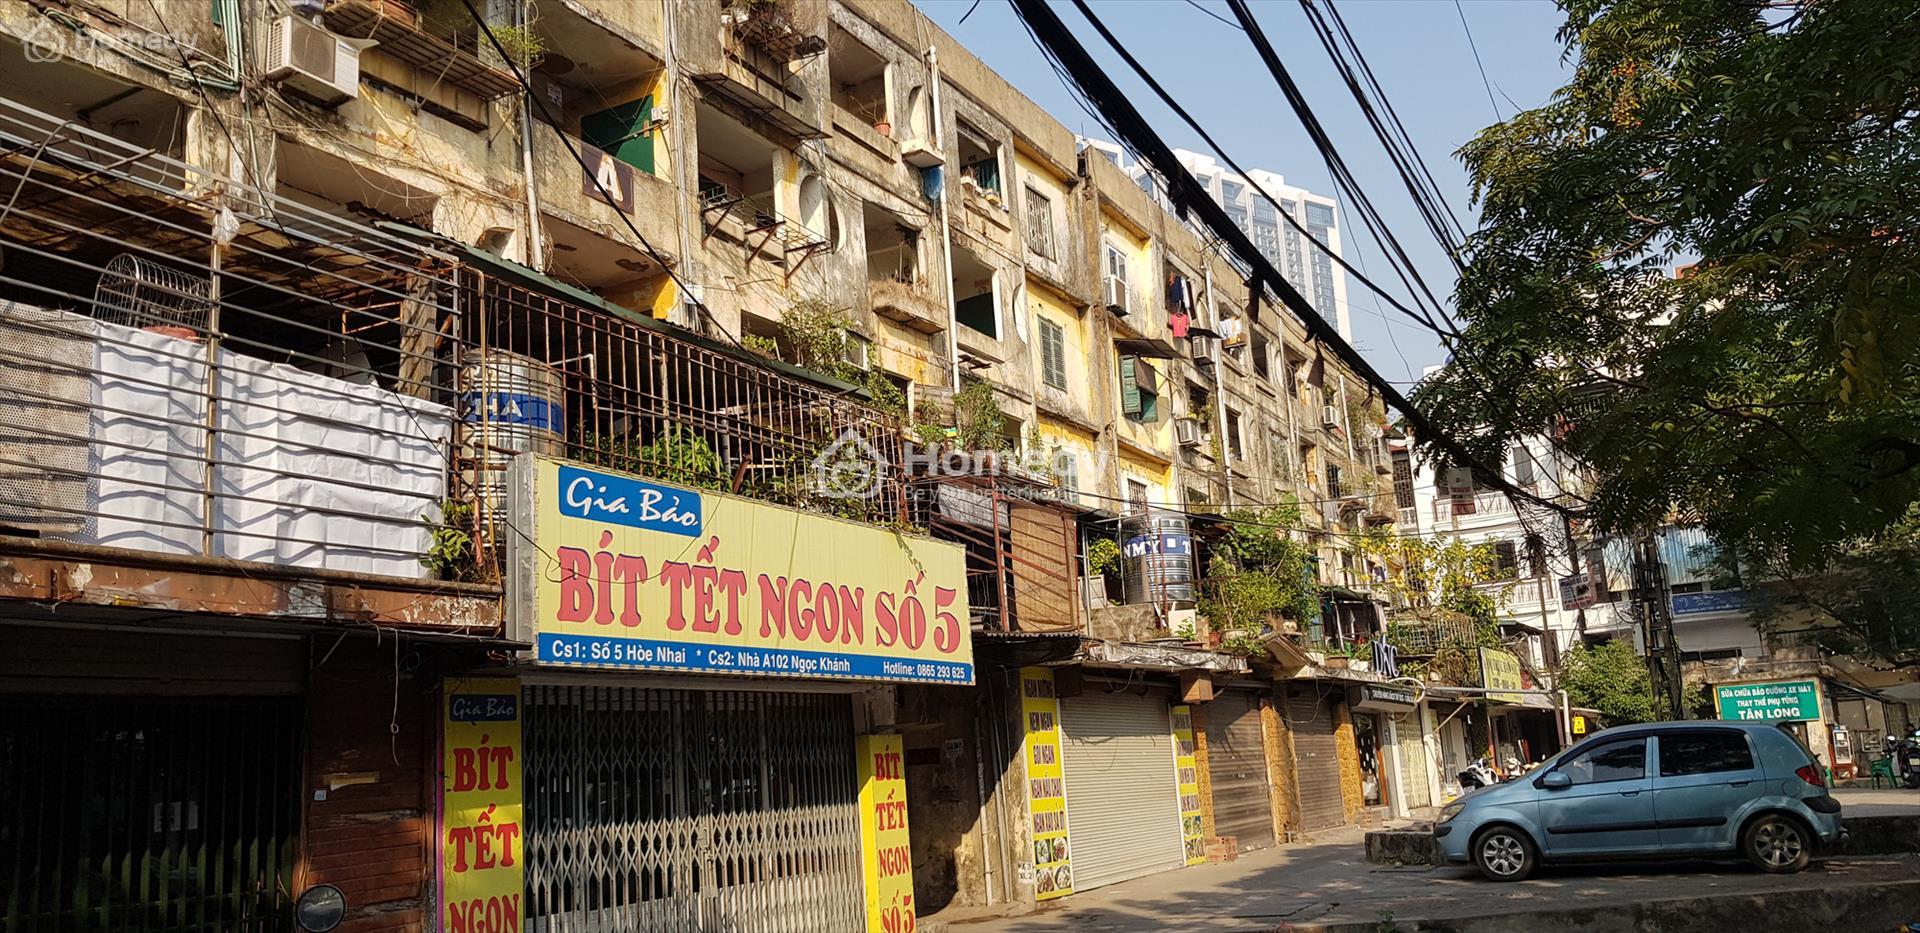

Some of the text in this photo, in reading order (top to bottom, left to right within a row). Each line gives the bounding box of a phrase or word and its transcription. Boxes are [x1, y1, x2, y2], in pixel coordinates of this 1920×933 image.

[593, 153, 624, 201] A
[567, 476, 630, 516] Gia
[556, 529, 961, 654] BÍT TẾT NGON SỐ 5
[551, 639, 586, 659] Cs1:
[591, 640, 612, 660] Số
[614, 644, 623, 660] 5
[626, 643, 653, 662] Hòe
[656, 646, 686, 664] Nhai
[707, 649, 735, 666] Cs2:
[737, 651, 760, 668] Nhà
[762, 653, 789, 669] A102
[791, 655, 817, 673] Ngọc
[819, 656, 850, 673] Khánh
[883, 660, 916, 676] Hotline:
[917, 663, 936, 678] 0865
[937, 664, 951, 679] 293
[952, 665, 965, 679] 625
[452, 697, 515, 718] Gia Bảo
[1736, 699, 1753, 708] THAY
[1788, 685, 1797, 694] XE
[1738, 707, 1800, 720] TÂN LONG
[452, 733, 514, 793] BÍT
[874, 744, 901, 781] BÍT
[875, 788, 906, 831] TẾT
[448, 802, 519, 873] TẾT
[878, 845, 910, 879] NGON
[448, 893, 520, 933] NGON
[881, 888, 915, 933] SỐ 5
